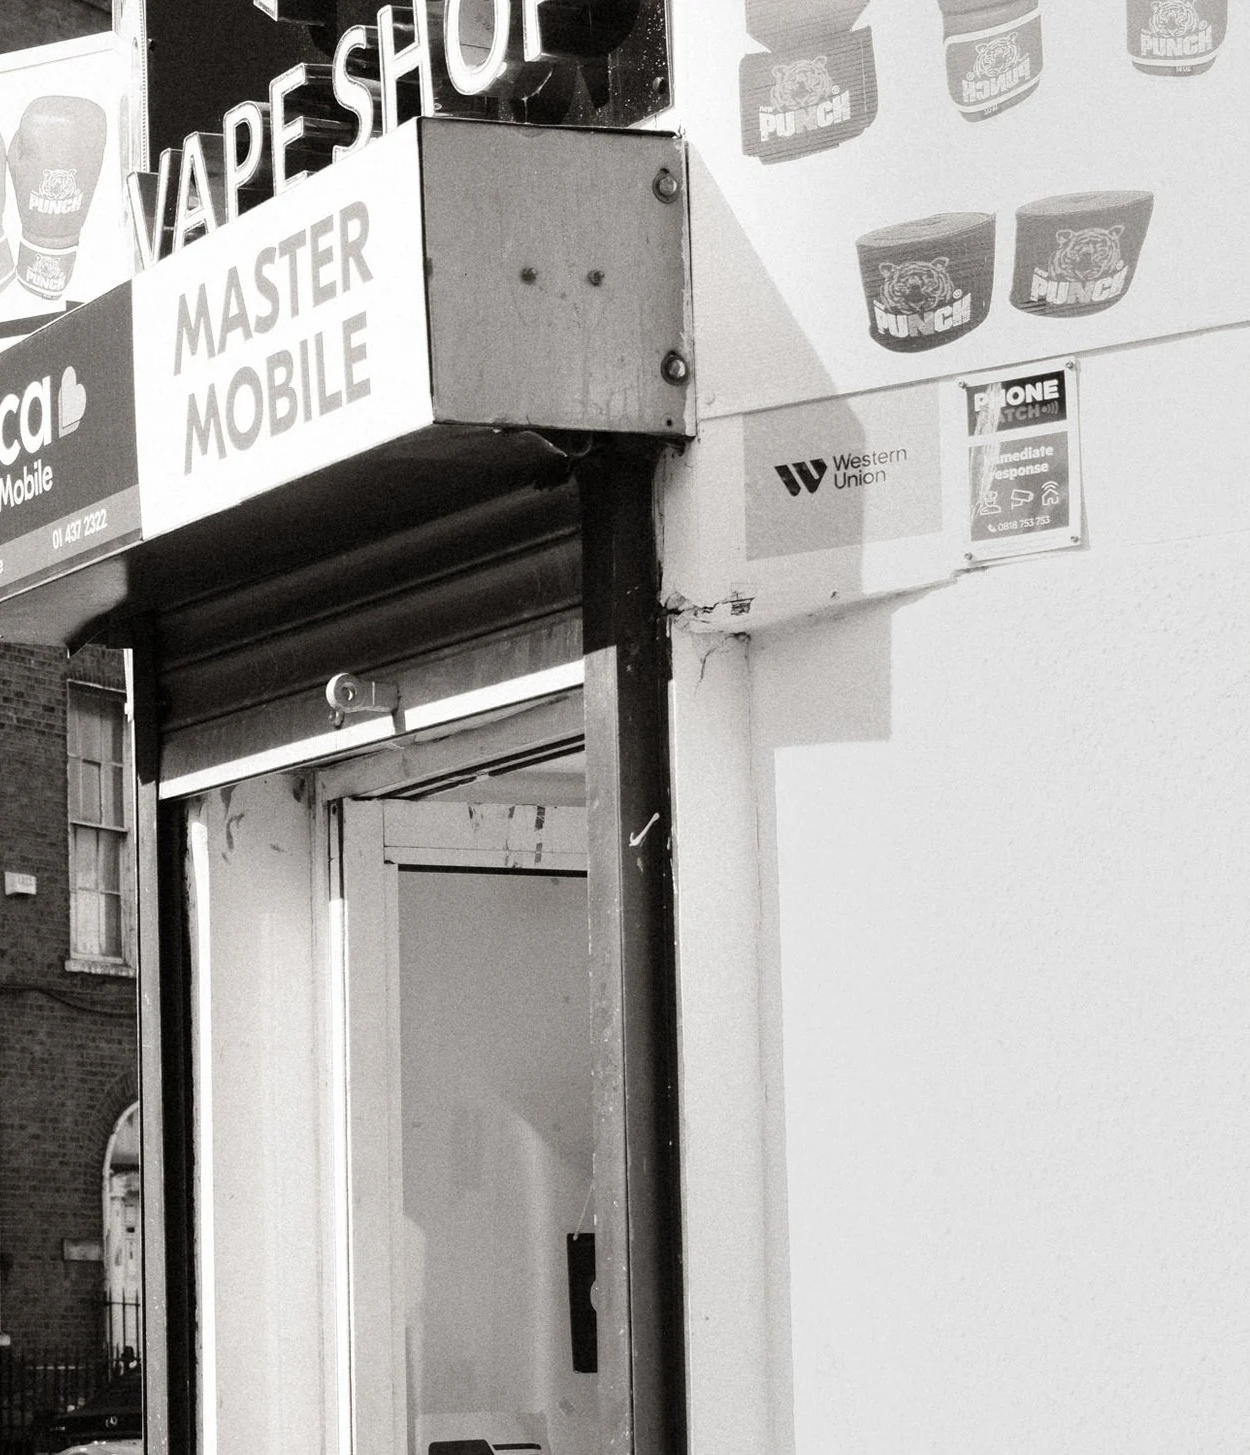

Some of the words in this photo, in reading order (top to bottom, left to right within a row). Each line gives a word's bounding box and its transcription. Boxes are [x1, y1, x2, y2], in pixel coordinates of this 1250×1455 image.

[1141, 24, 1213, 57] PUNCH
[759, 89, 851, 142] PUNCH
[127, 63, 308, 267] VAPE
[29, 189, 83, 215] PUNCH
[173, 200, 374, 377] MASTER
[1030, 265, 1128, 305] PUNCH
[873, 293, 972, 338] PUNCH
[184, 310, 372, 476] MOBILE
[833, 447, 908, 472] Western
[834, 468, 887, 490] Union
[52, 529, 64, 550] 01
[65, 520, 83, 545] 437
[84, 508, 108, 537] 2322
[997, 519, 1018, 532] 0818
[1019, 517, 1035, 528] 753
[1035, 516, 1051, 527] 753
